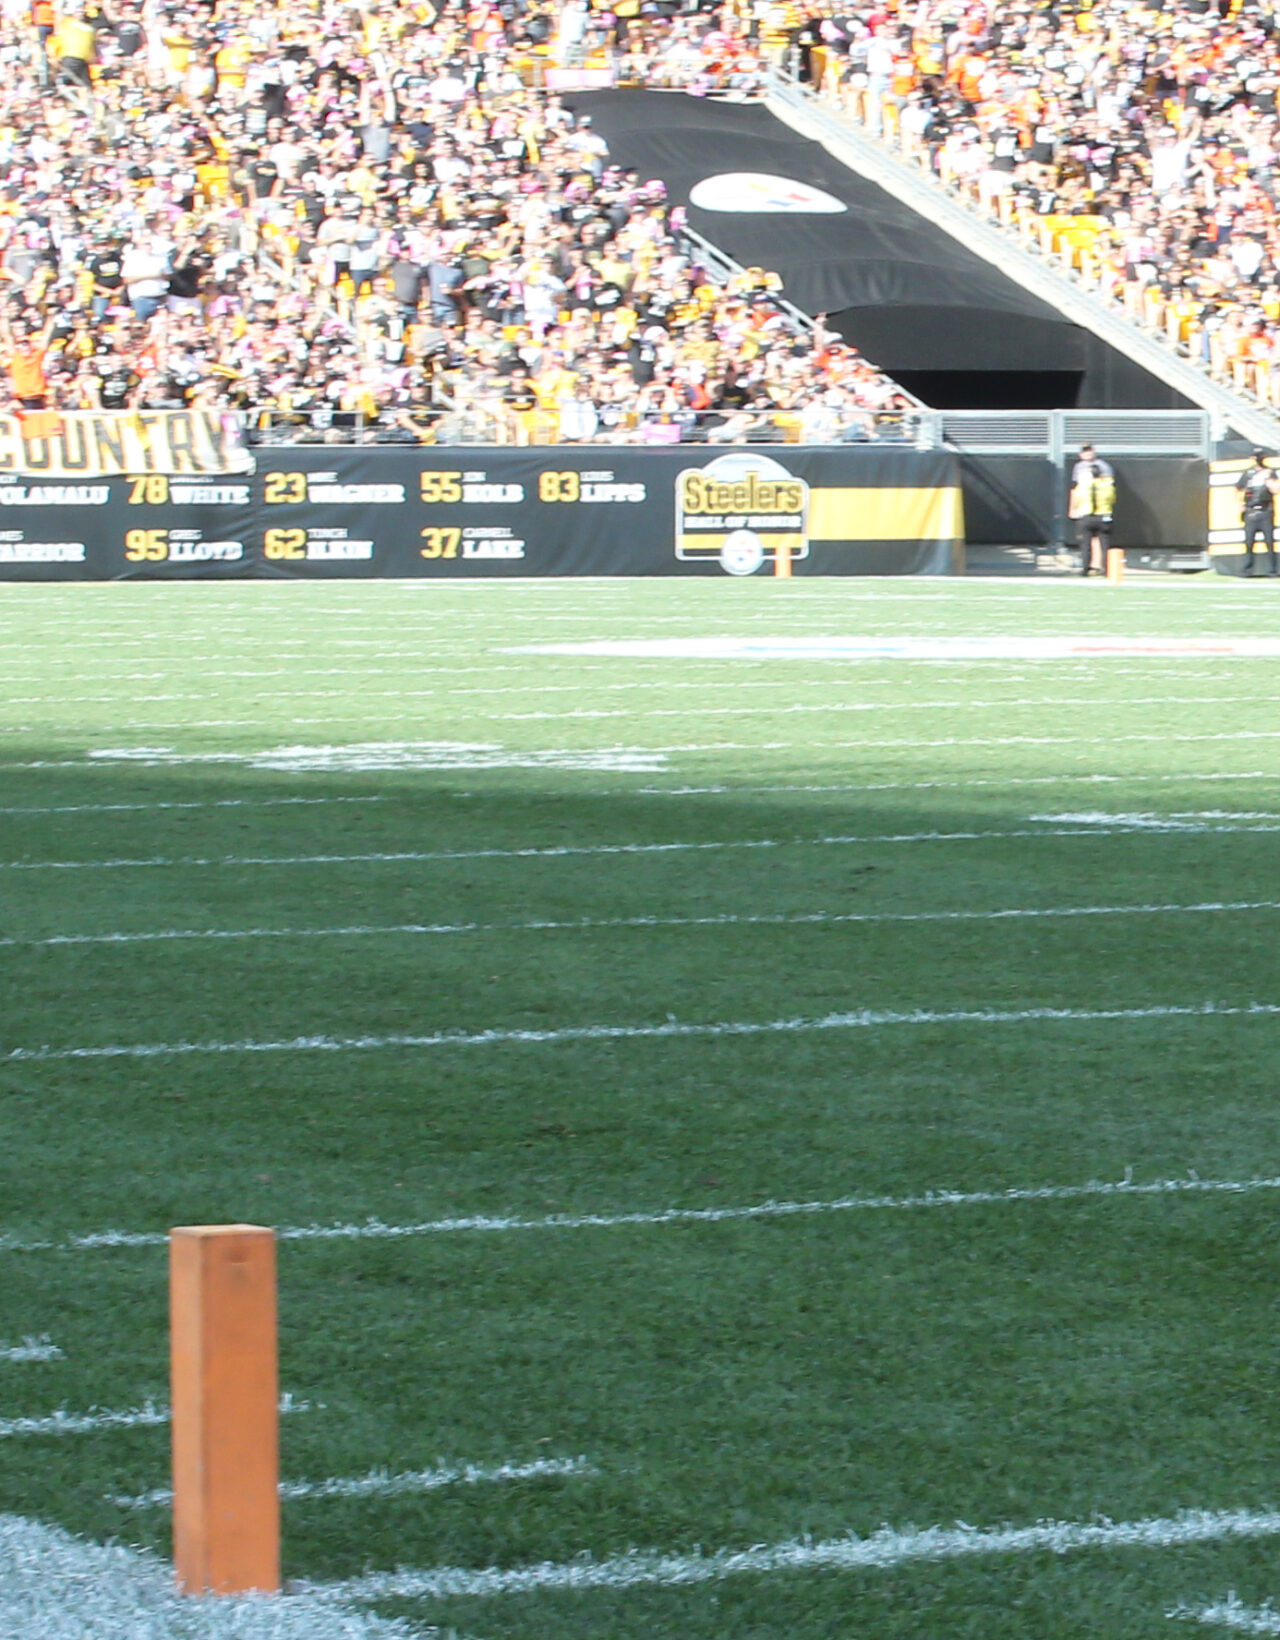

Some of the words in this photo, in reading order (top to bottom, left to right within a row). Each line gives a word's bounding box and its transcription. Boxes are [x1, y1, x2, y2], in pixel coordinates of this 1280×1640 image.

[125, 474, 168, 505] 78
[264, 472, 306, 503] 23
[420, 471, 462, 503] 55
[539, 471, 579, 502] 83
[683, 472, 804, 513] Steelers
[125, 529, 168, 561] 95
[168, 542, 243, 561] LLOYD
[264, 529, 306, 559] 62
[420, 527, 462, 559] 37
